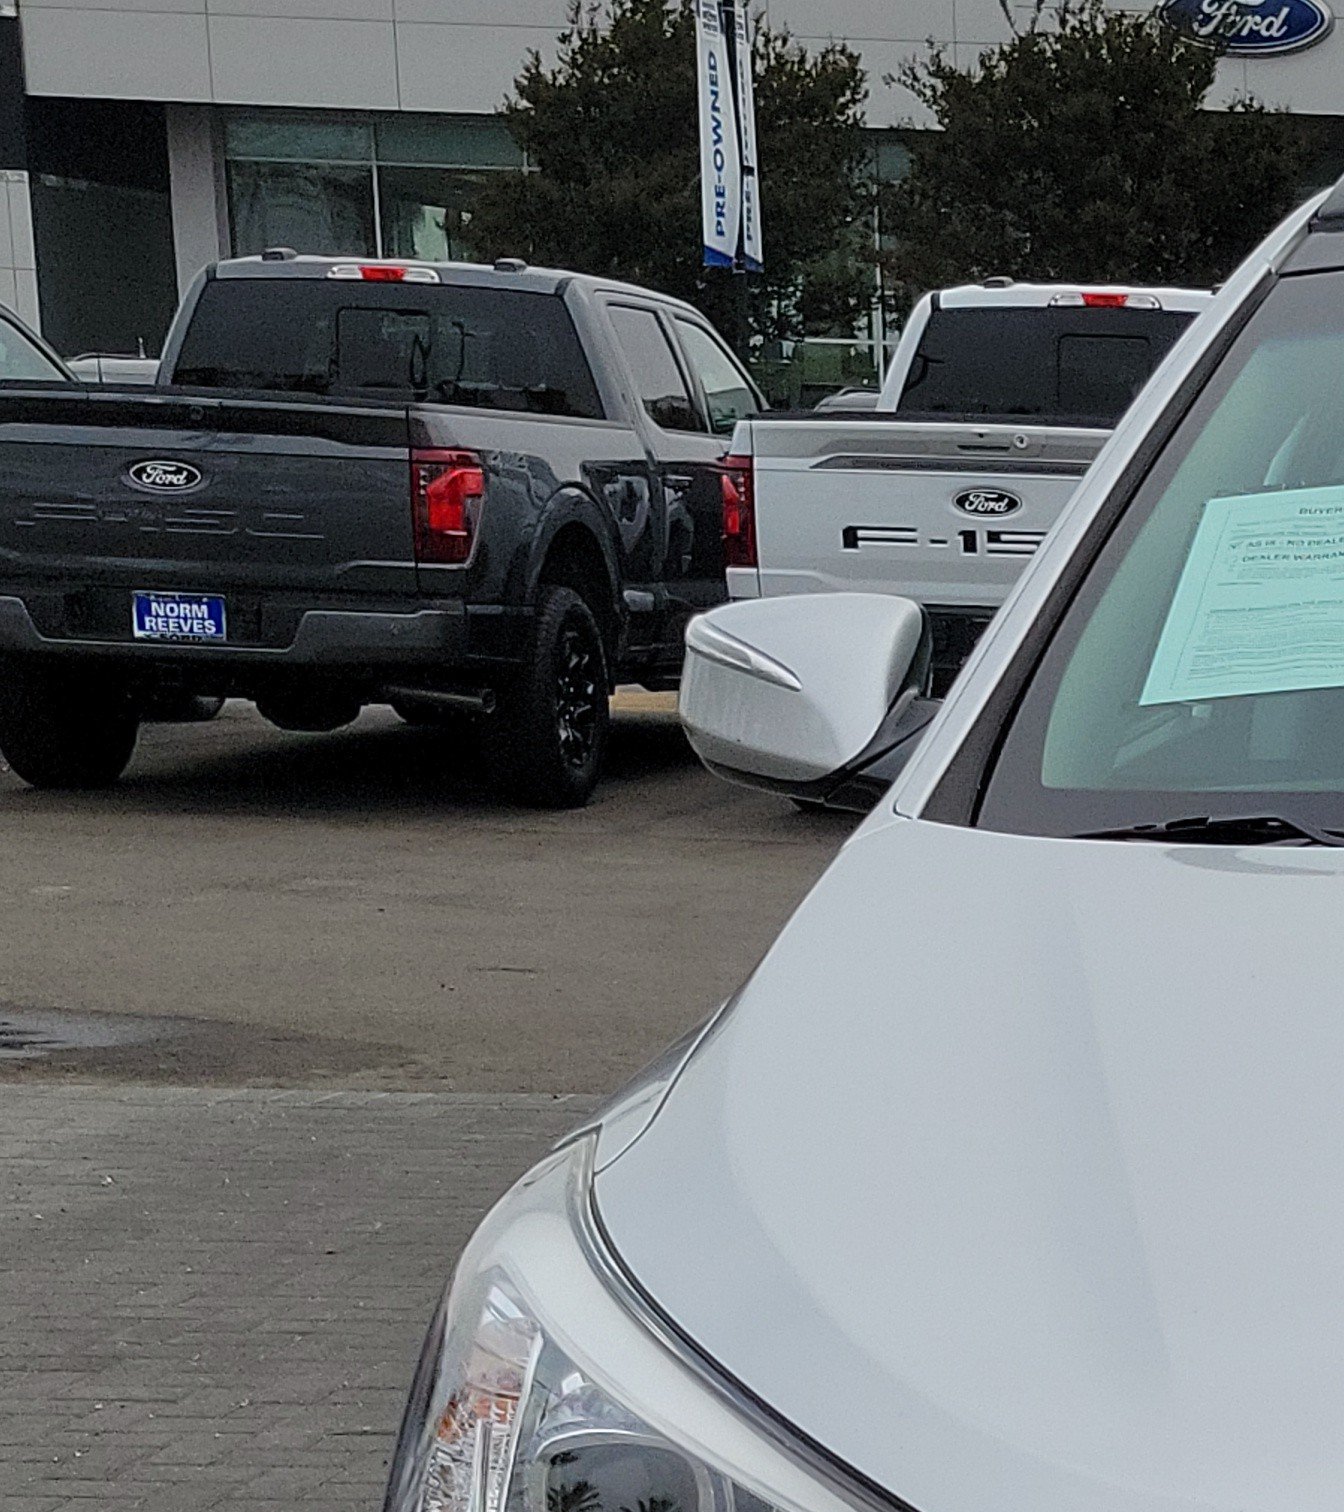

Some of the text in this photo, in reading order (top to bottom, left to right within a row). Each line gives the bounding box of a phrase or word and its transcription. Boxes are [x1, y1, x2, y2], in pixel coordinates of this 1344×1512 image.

[1193, 0, 1290, 37] Ford
[708, 51, 726, 237] PRE-OWNED
[142, 465, 188, 485] Ford
[964, 490, 1009, 514] Ford
[150, 602, 209, 619] NORM
[144, 616, 217, 635] REEVES
